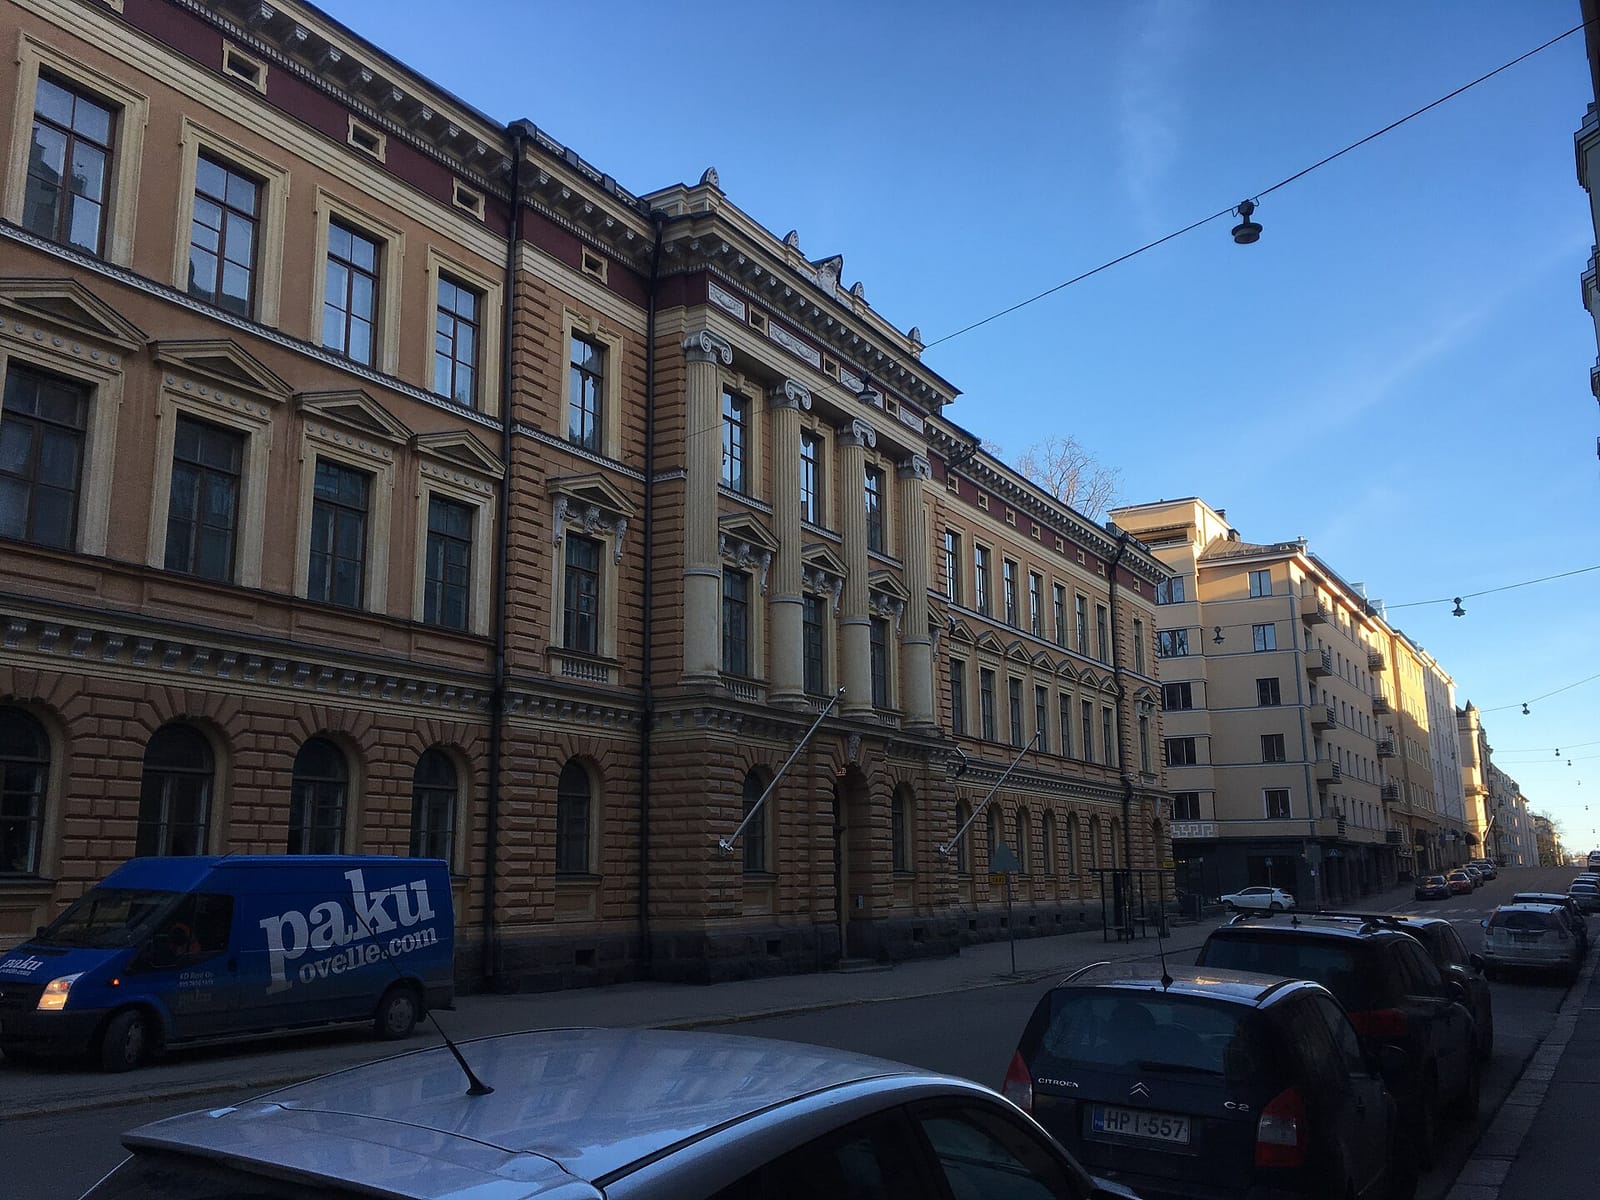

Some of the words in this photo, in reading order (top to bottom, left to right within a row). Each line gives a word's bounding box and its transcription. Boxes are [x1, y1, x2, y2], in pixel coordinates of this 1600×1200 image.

[259, 868, 436, 994] paku
[298, 927, 439, 984] ovelle.com
[1223, 1100, 1250, 1113] C2
